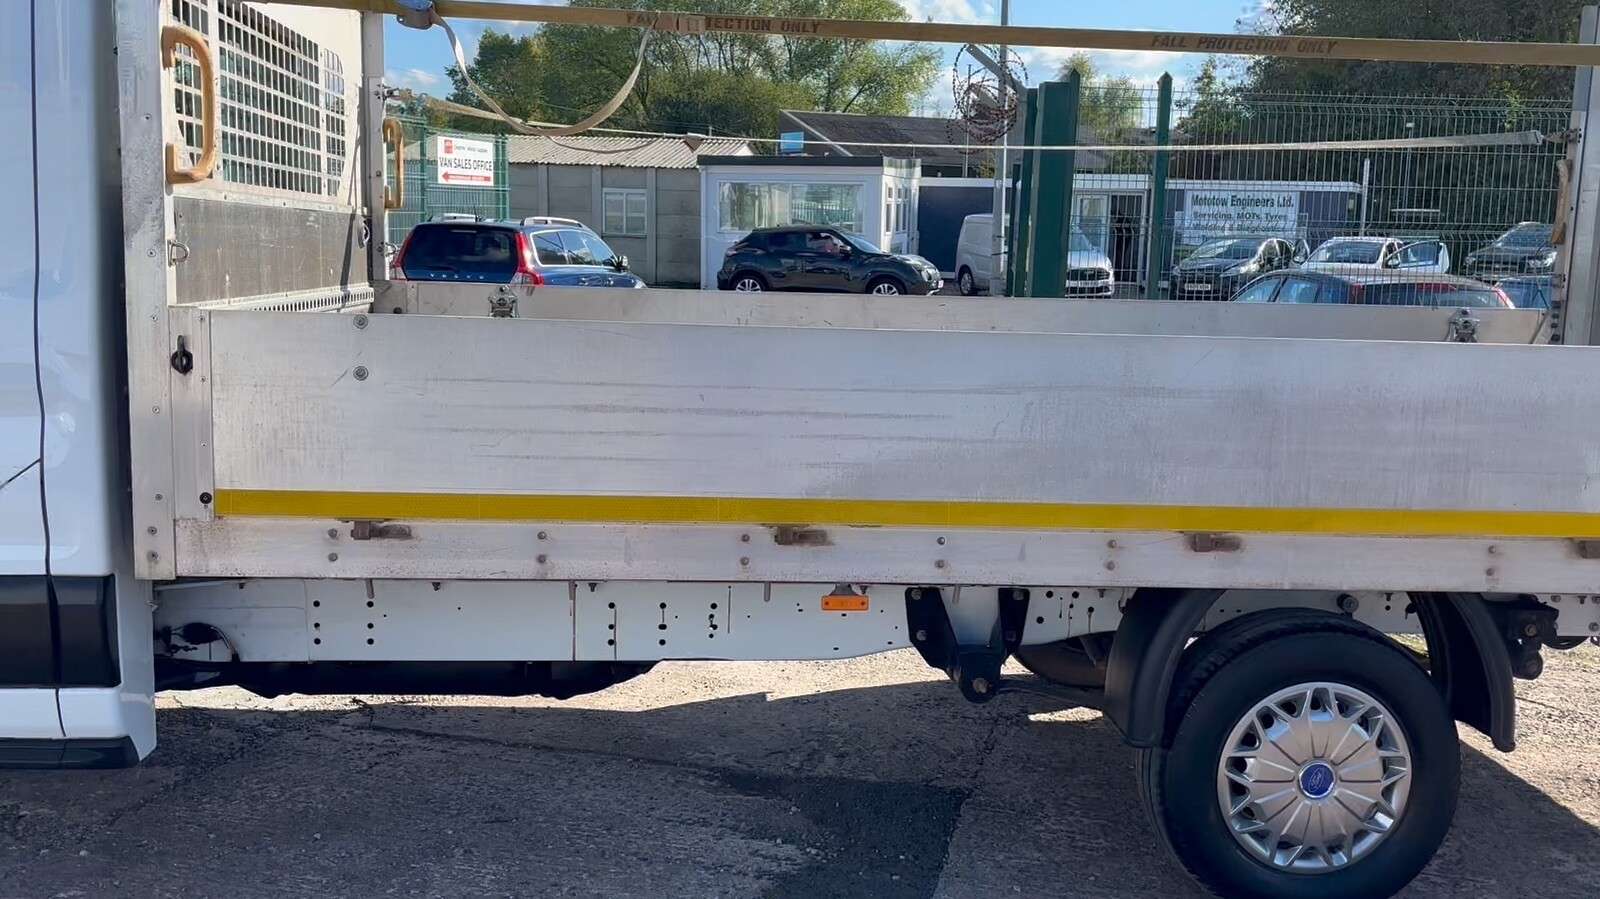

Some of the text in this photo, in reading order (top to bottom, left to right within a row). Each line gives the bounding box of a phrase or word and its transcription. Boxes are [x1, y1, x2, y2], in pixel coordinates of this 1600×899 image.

[781, 20, 820, 34] ONLY
[1151, 35, 1339, 54] FALL PROTECTION ONLY
[439, 157, 492, 171] VAN SALES OFFICE
[1192, 194, 1295, 210] Mototow Engineers Ltd.
